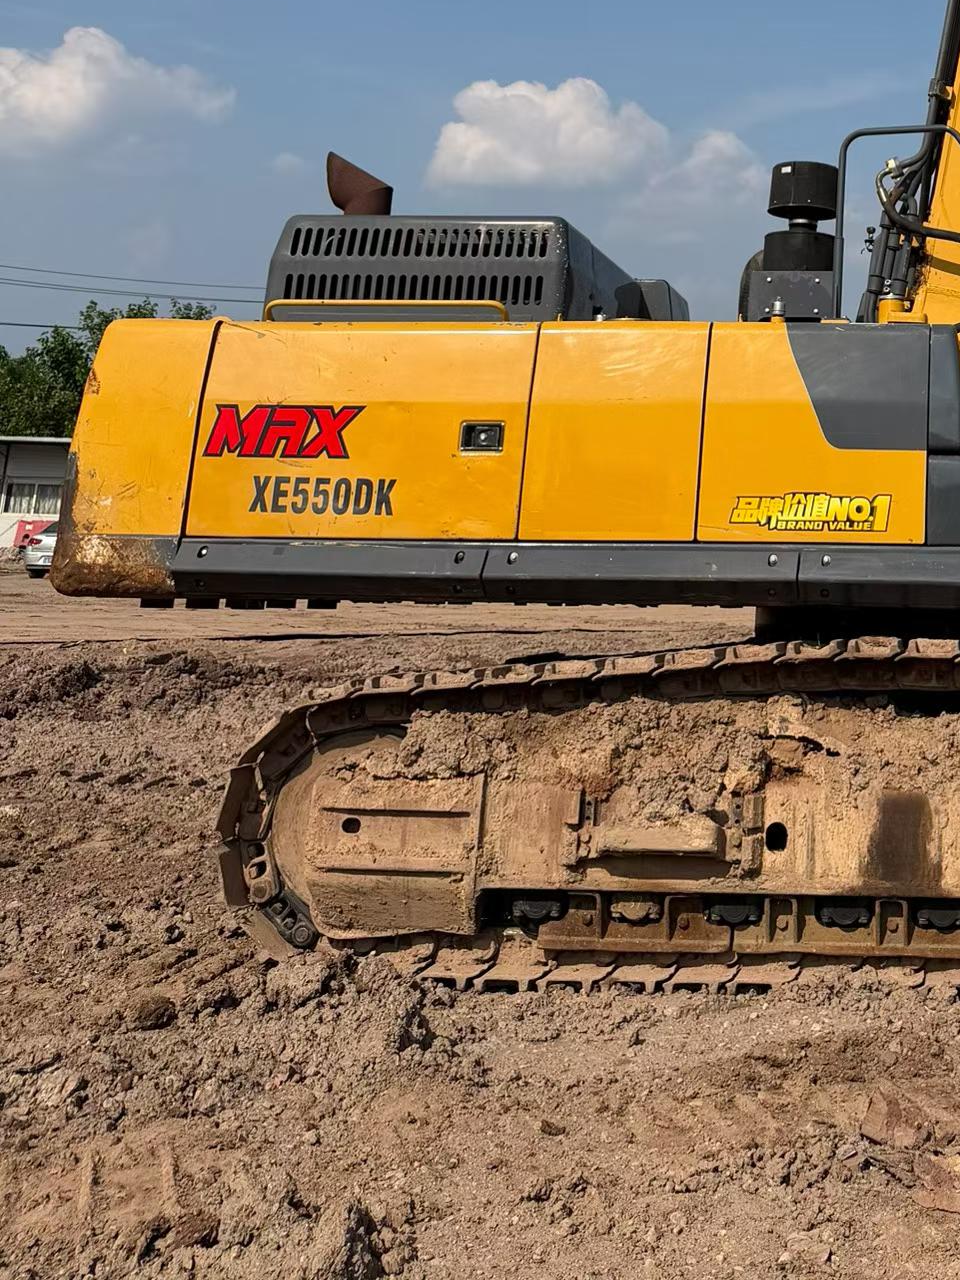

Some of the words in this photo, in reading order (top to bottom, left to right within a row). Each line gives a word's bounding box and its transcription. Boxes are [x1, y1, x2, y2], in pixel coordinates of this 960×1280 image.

[202, 403, 367, 459] MAX
[248, 475, 397, 516] XE550DK
[777, 521, 823, 531] BRAND
[828, 521, 872, 531] VALUE
